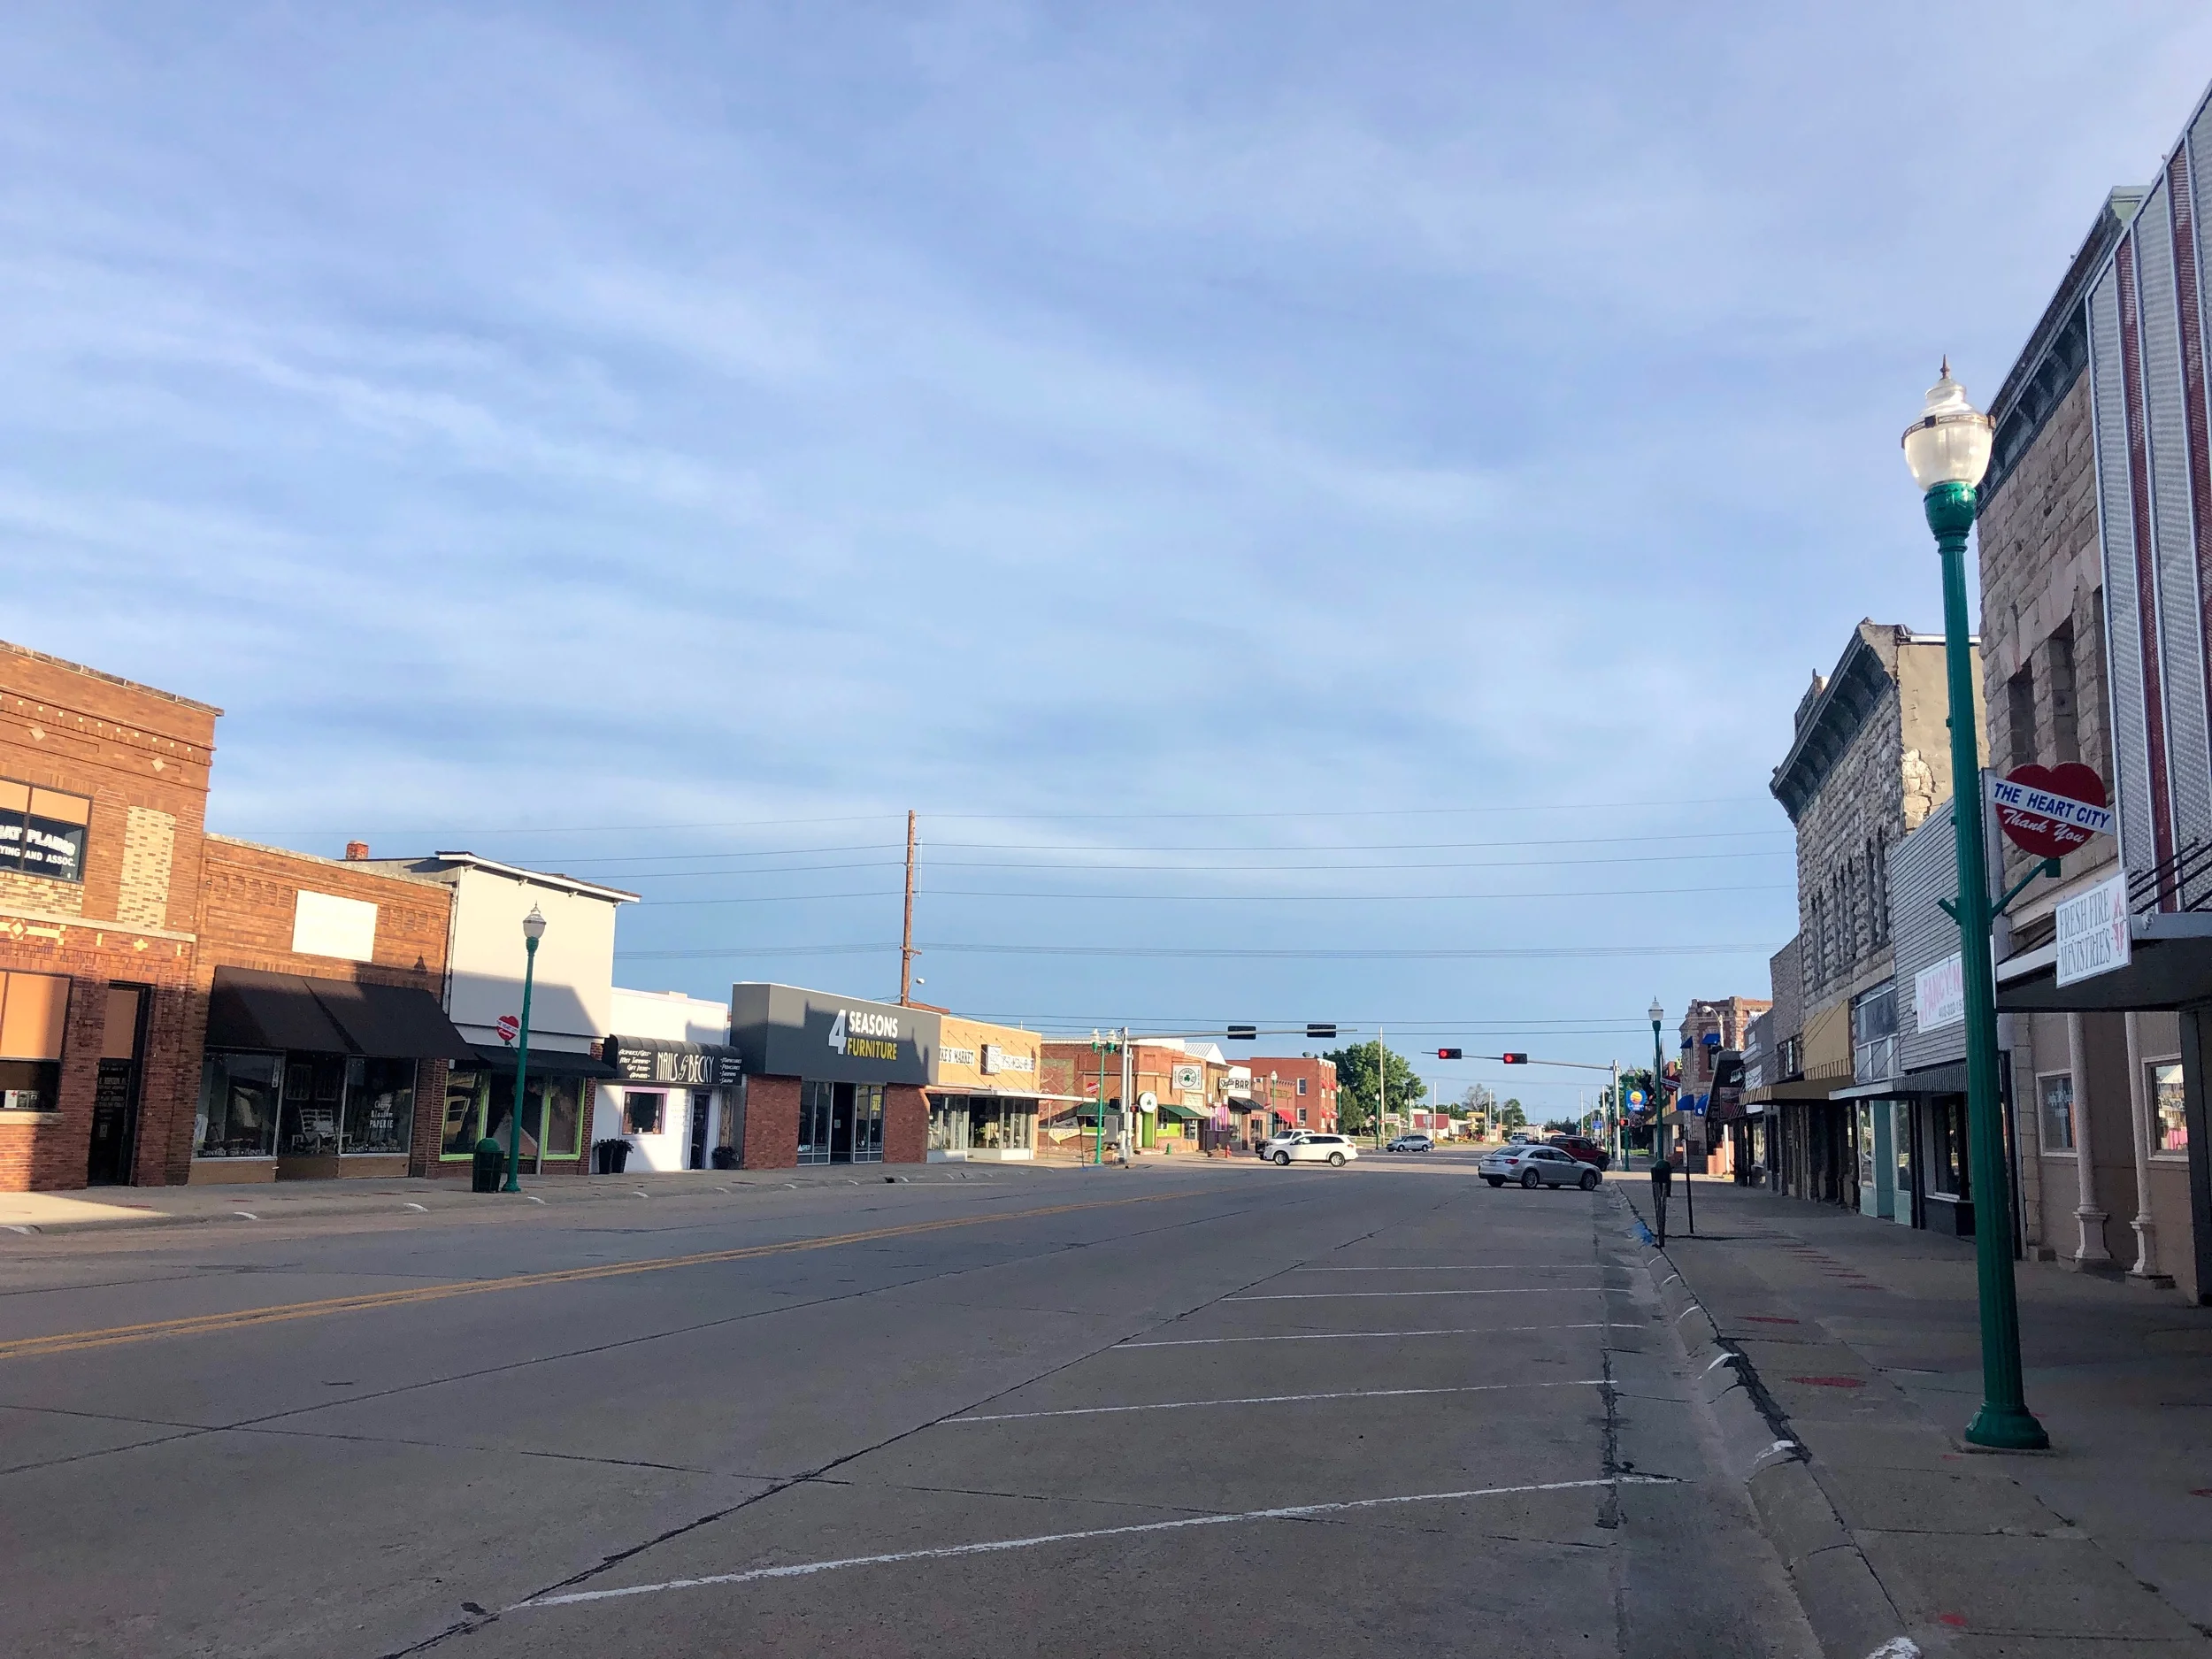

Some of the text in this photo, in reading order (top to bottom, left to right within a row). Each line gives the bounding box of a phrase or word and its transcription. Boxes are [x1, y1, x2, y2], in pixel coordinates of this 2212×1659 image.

[1994, 782, 2111, 829] THE HEART CITY
[2003, 809, 2085, 843] Thank You
[26, 828, 76, 856] PLAINS
[25, 849, 42, 861] AND
[46, 854, 76, 867] ASSOC.
[2060, 887, 2110, 941] FRESH FIRE
[2060, 928, 2111, 979] MINISTRIES
[828, 1009, 898, 1055] 4 SEASONS
[847, 1037, 897, 1060] FURNITURE
[954, 1050, 974, 1064] MARKET
[657, 1051, 678, 1081] NAILS
[687, 1054, 715, 1083] BECKY
[1234, 1079, 1249, 1090] BAR
[369, 1119, 394, 1129] PAPERIE
